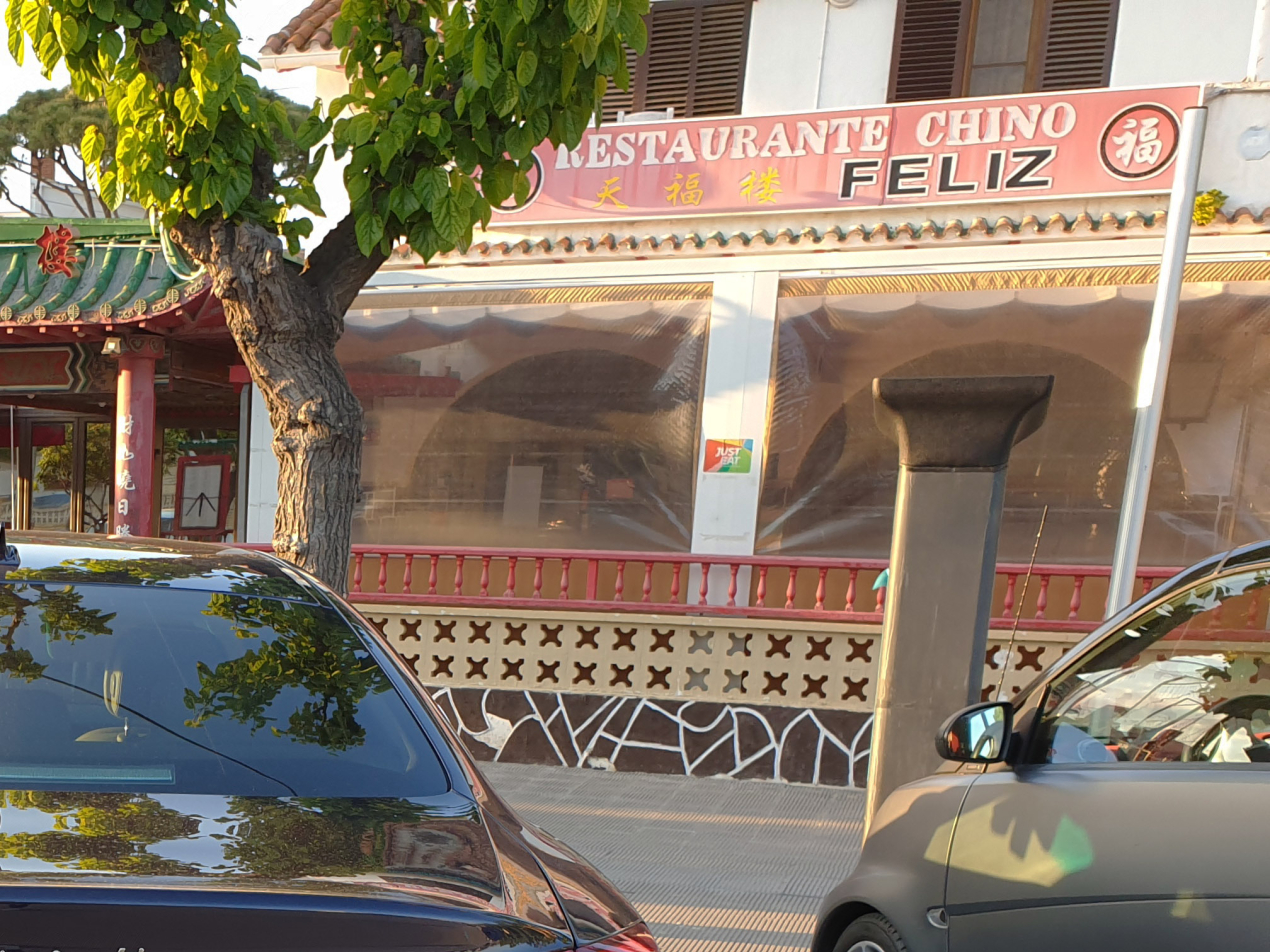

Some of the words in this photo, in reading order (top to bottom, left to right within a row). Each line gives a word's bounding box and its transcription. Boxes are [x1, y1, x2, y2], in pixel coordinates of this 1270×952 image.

[555, 114, 891, 169] RESTAURANTE
[915, 101, 1078, 147] CHINO
[1112, 117, 1164, 168] 福
[838, 145, 1058, 200] FELIZ
[715, 447, 741, 458] JUST
[722, 456, 741, 466] EAT
